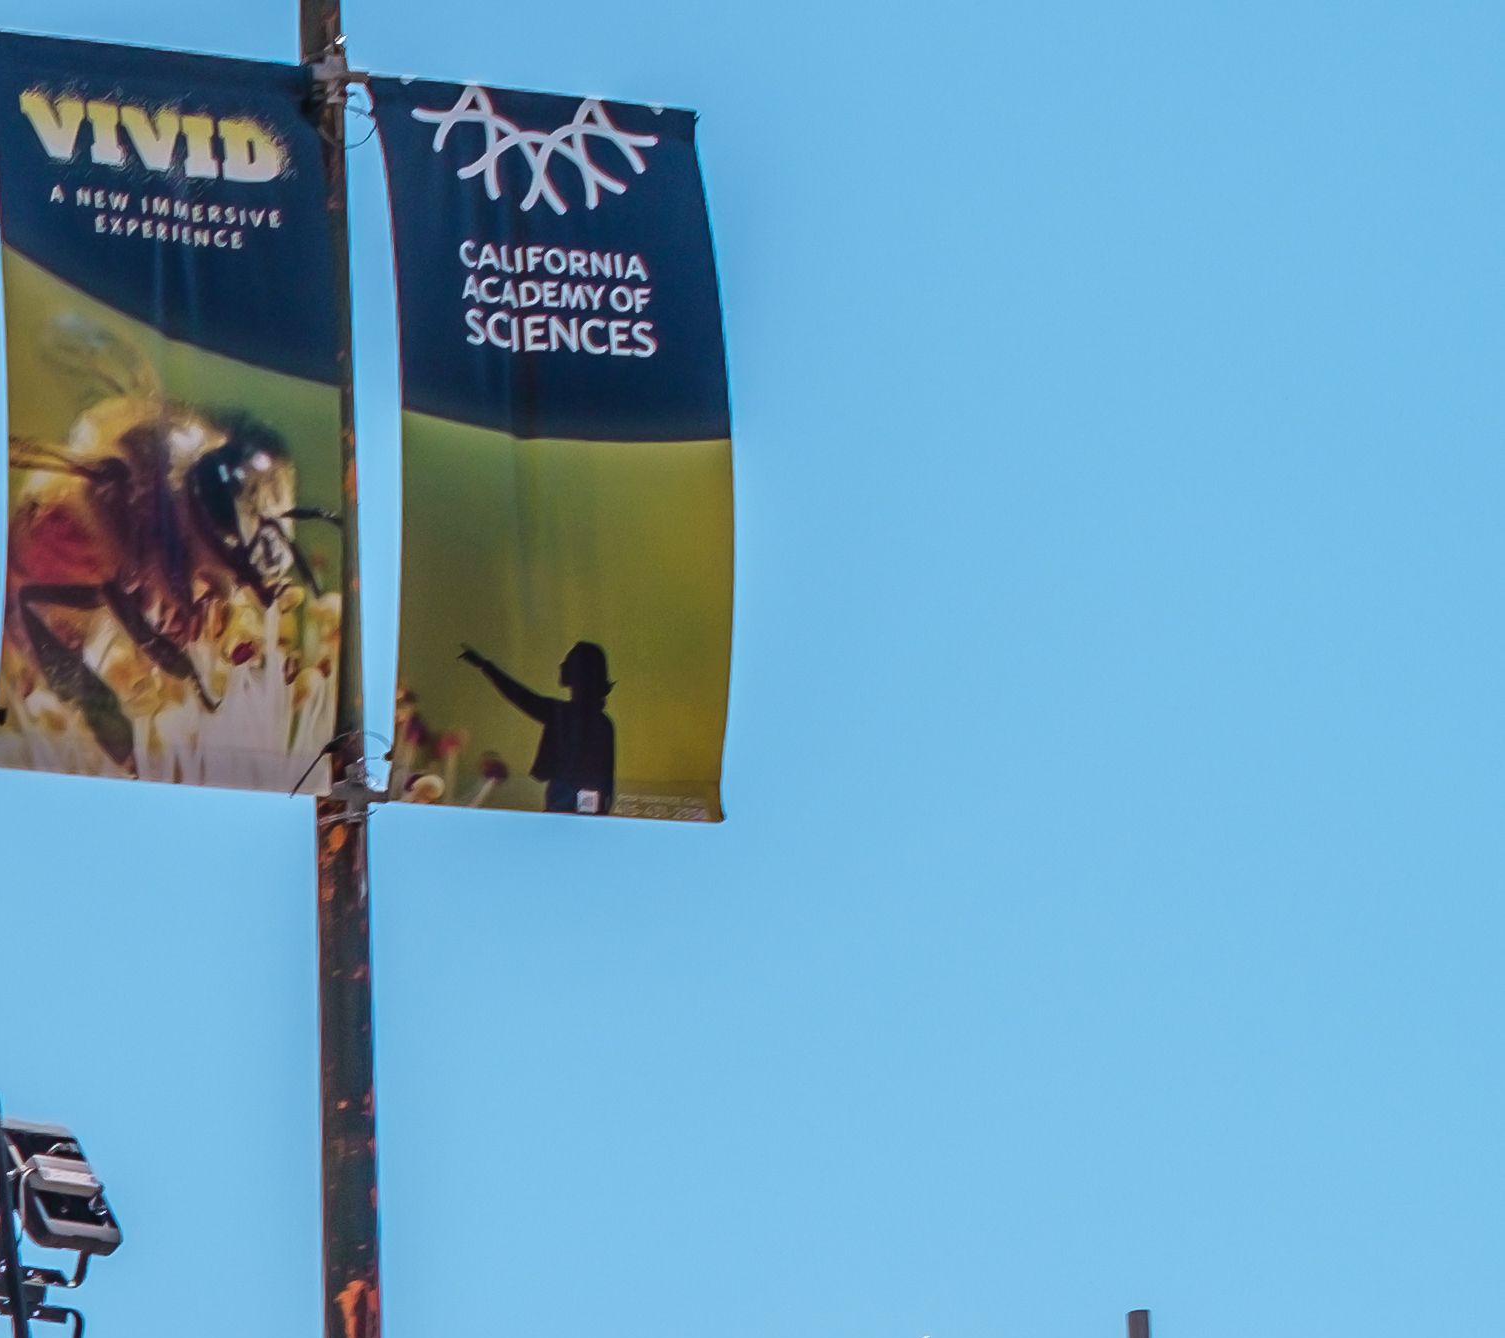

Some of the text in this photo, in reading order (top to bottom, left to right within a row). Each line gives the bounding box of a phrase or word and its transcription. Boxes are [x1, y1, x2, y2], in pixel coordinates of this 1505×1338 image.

[19, 91, 288, 183] VIVID
[50, 184, 282, 228] A NEW IMMERSIVE
[95, 214, 244, 249] EXPERIENCE
[459, 240, 649, 281] CALIFORNIA
[462, 274, 652, 313] ACADEMY OF
[464, 308, 658, 358] SCIENCES
